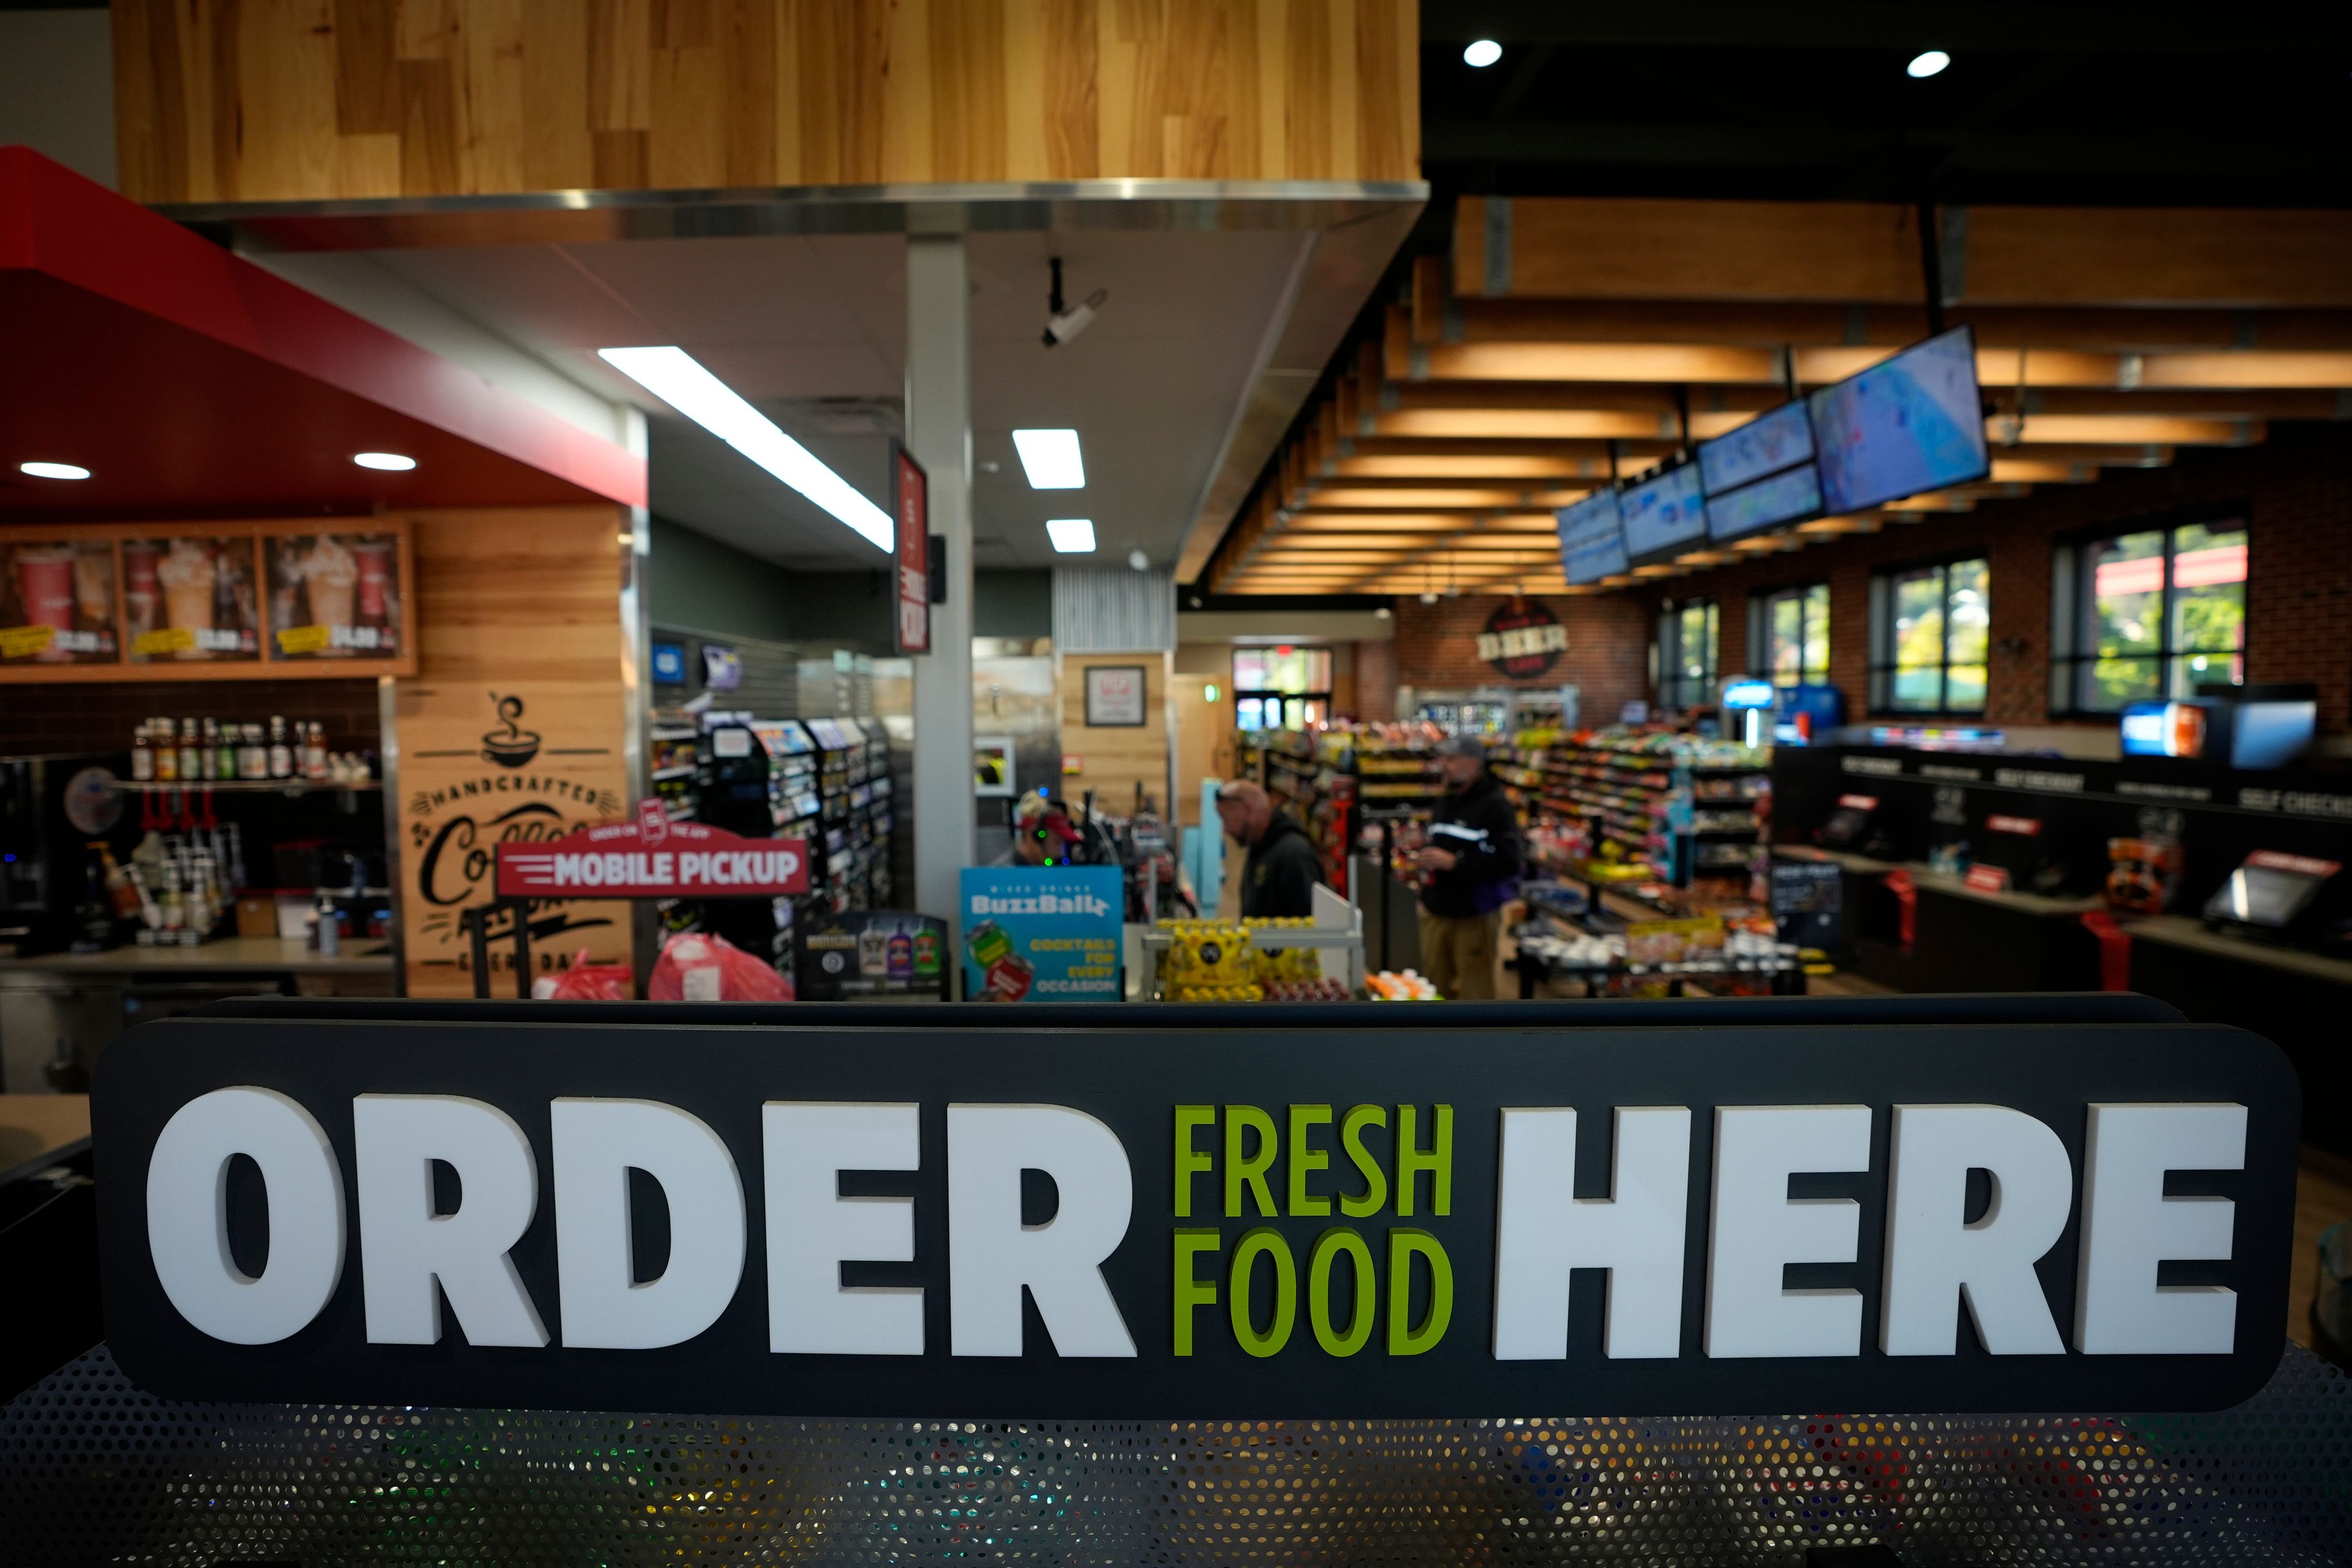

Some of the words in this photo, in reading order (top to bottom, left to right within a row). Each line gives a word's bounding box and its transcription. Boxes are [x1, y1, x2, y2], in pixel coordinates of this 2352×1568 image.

[431, 774, 597, 807] HANDCRAFTED
[553, 851, 673, 886] MOBILE
[679, 850, 799, 884] PICKUP
[1030, 938, 1115, 951] COCKTAILS
[1085, 952, 1115, 964] FOR
[1036, 980, 1116, 992] OCCASION
[146, 1085, 1138, 1360] ORDER
[1174, 1103, 1453, 1218] FRESH
[1493, 1101, 2248, 1362] HERE
[1172, 1227, 1453, 1358] FOOD
